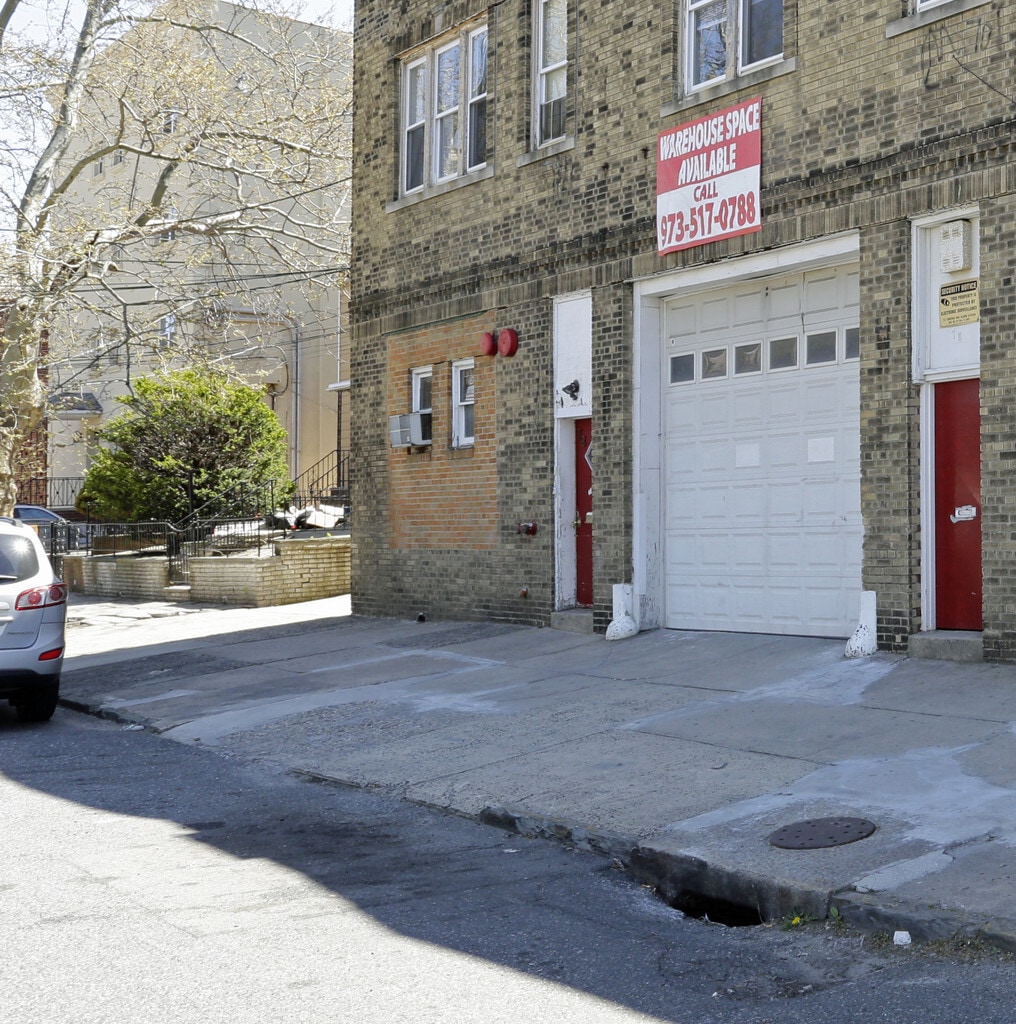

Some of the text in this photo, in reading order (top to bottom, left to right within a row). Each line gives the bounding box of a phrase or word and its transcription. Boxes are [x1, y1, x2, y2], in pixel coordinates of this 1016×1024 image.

[660, 102, 760, 162] WAREHOUSE SPACE
[678, 143, 737, 186] AVAILABLE
[694, 181, 718, 202] CALL
[661, 191, 756, 247] 973-517-0788
[941, 282, 977, 295] SECURITY NOTICE
